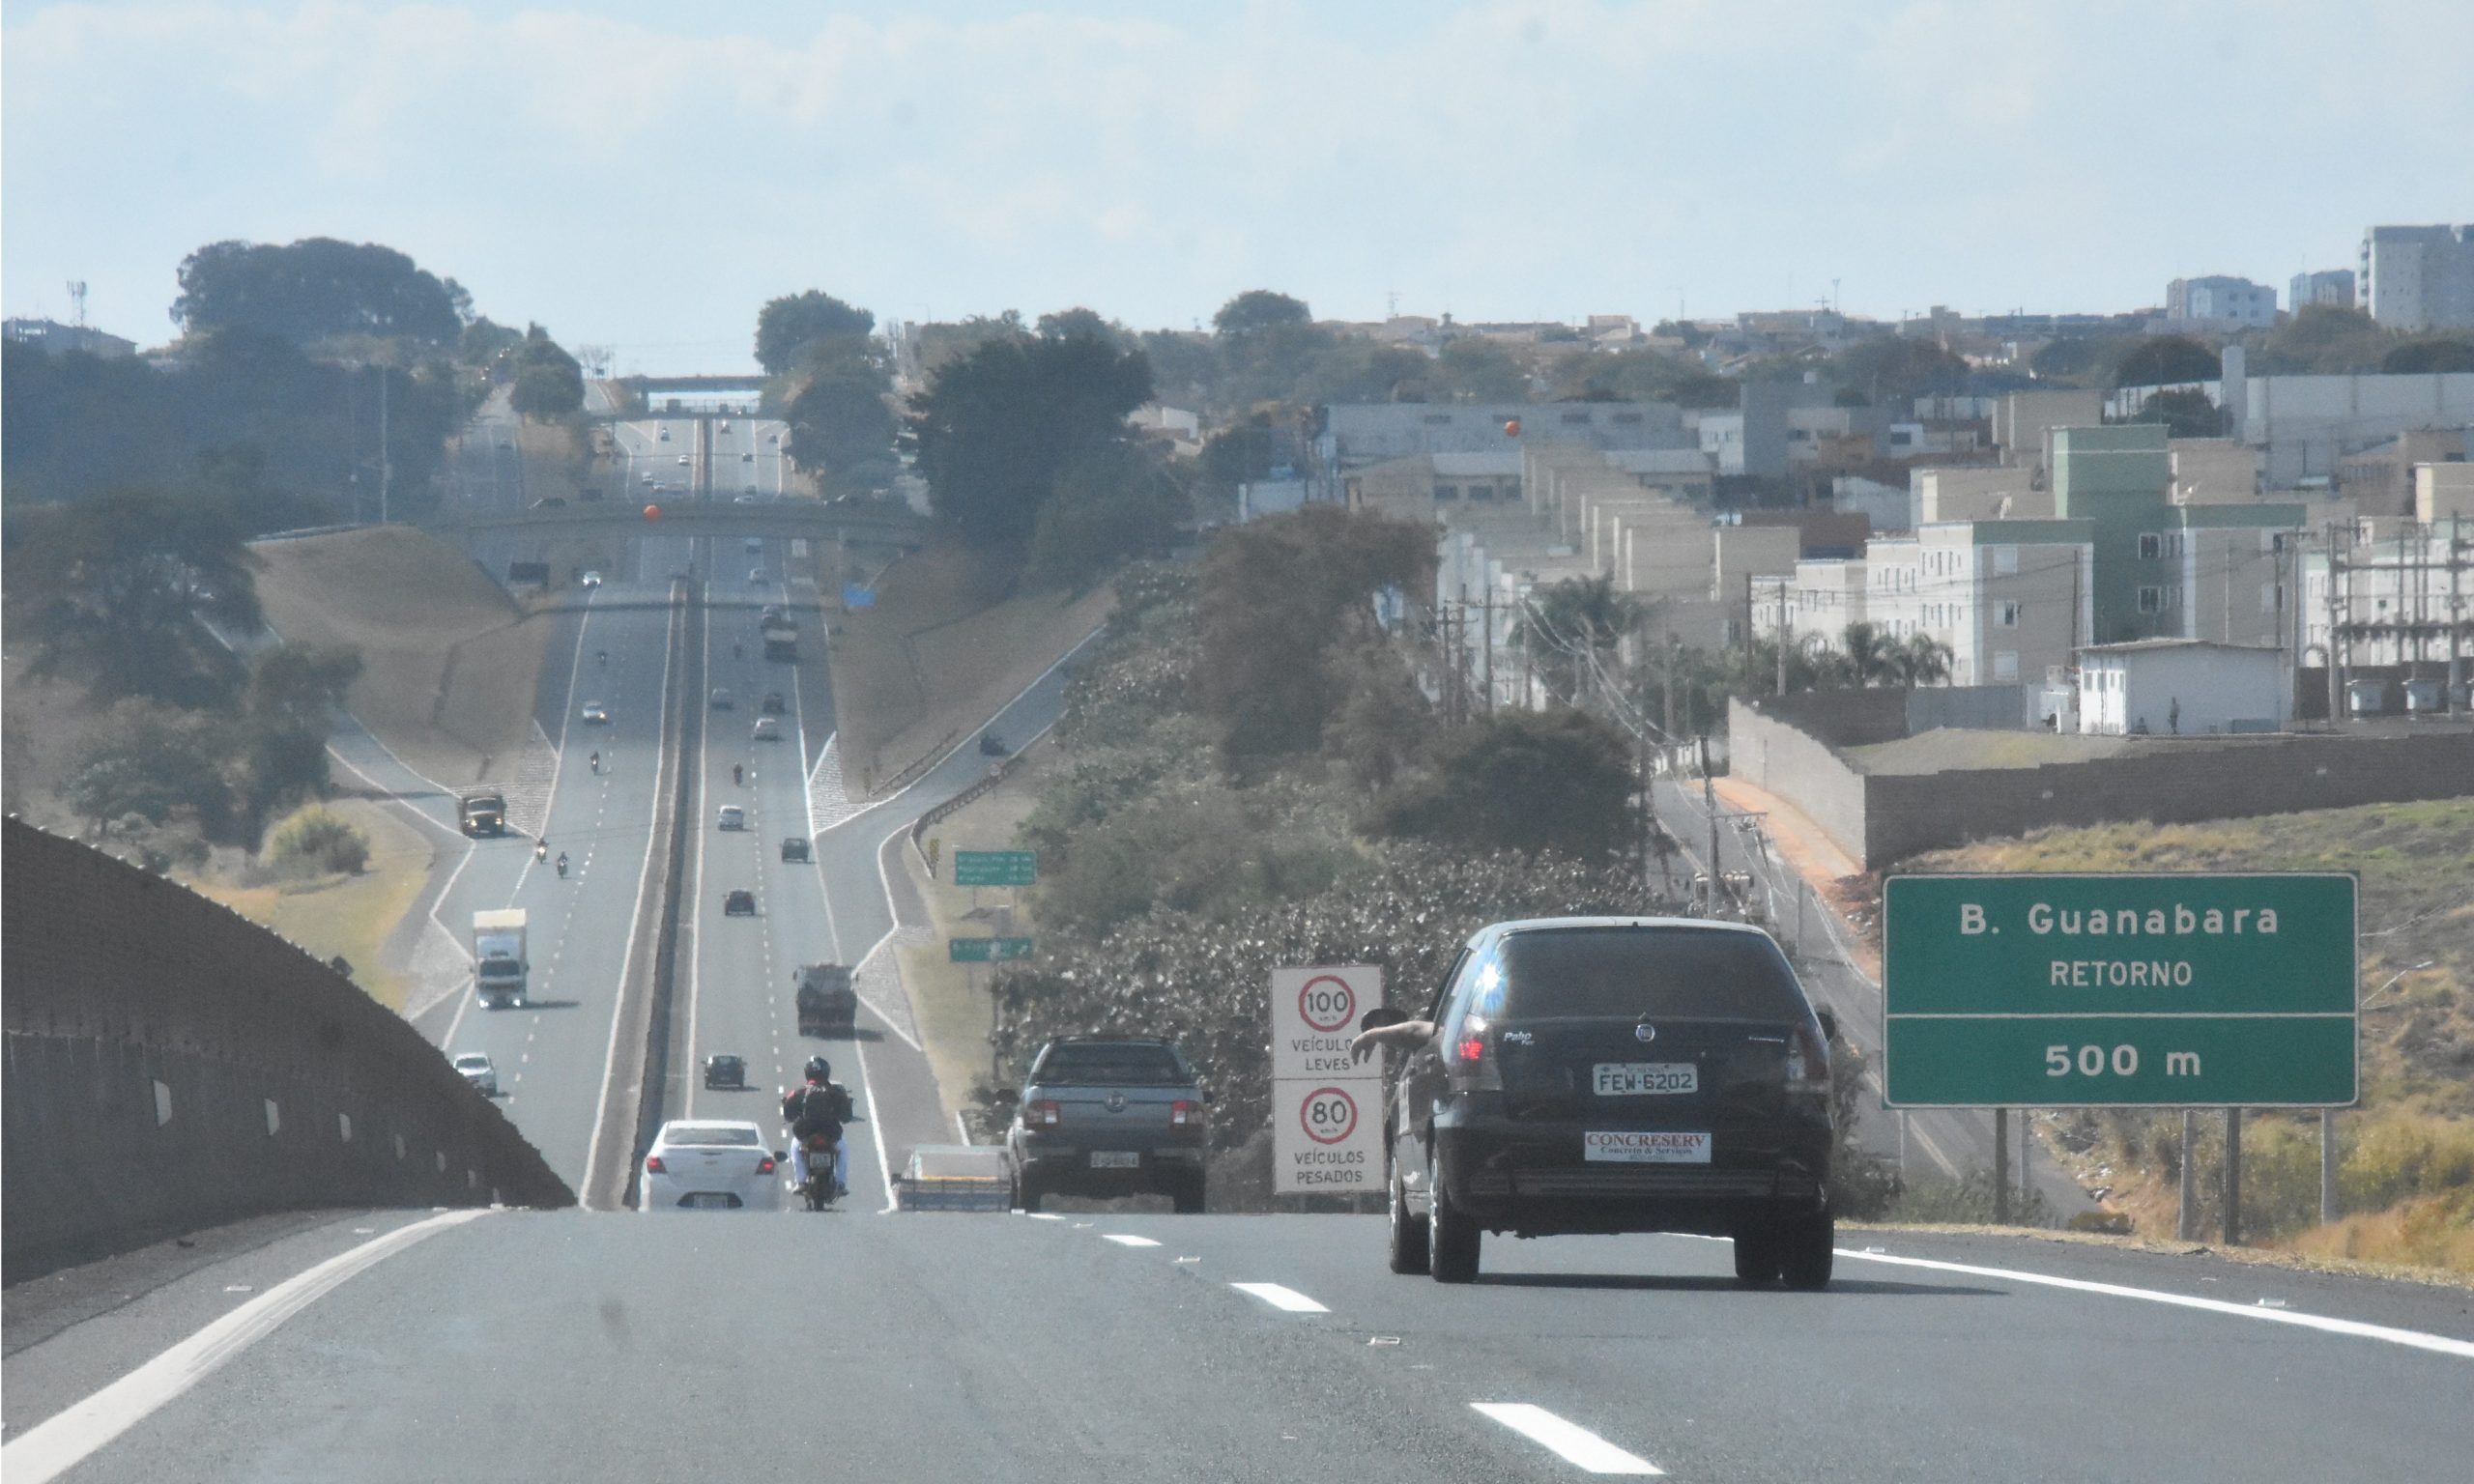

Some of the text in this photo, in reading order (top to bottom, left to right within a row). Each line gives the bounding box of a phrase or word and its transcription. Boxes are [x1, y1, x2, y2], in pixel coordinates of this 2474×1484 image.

[1961, 902, 2278, 934] B. Guanabara
[2051, 960, 2192, 986] RETORNO
[1308, 991, 1349, 1013] 100
[1292, 1035, 1353, 1052] VEÍCULO
[1306, 1058, 1351, 1070] LEVES
[2046, 1044, 2201, 1076] 500 m
[1312, 1100, 1347, 1124] 80
[1587, 1133, 1706, 1147] CONCRESERV
[1295, 1147, 1365, 1165] VEÍCULOS
[1297, 1170, 1363, 1184] PESADOS
